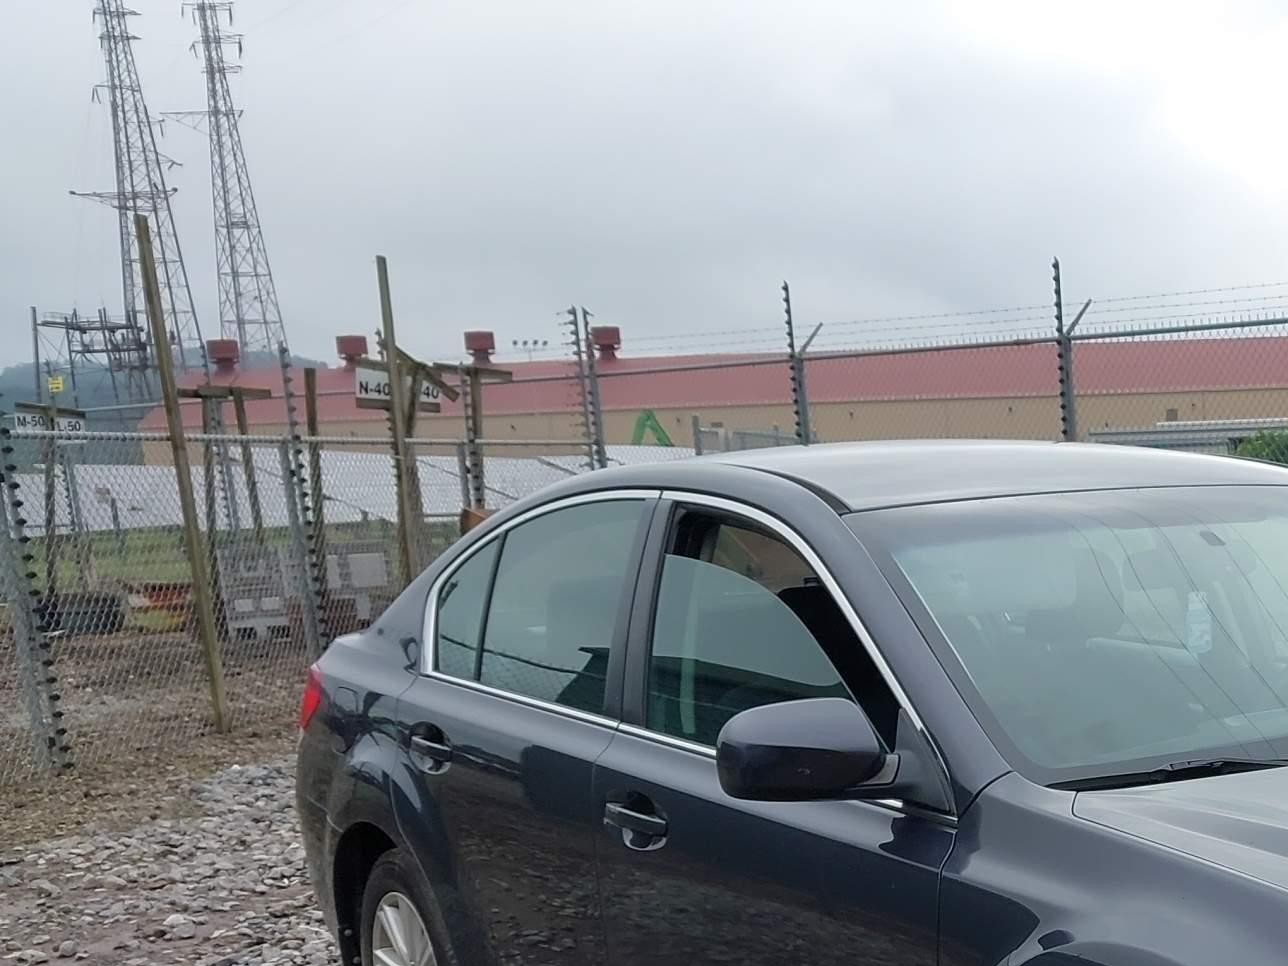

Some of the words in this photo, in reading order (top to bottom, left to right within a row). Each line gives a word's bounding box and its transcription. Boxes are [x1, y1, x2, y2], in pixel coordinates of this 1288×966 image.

[359, 381, 391, 396] N-40
[17, 415, 45, 427] M-50
[57, 421, 81, 432] L-50
